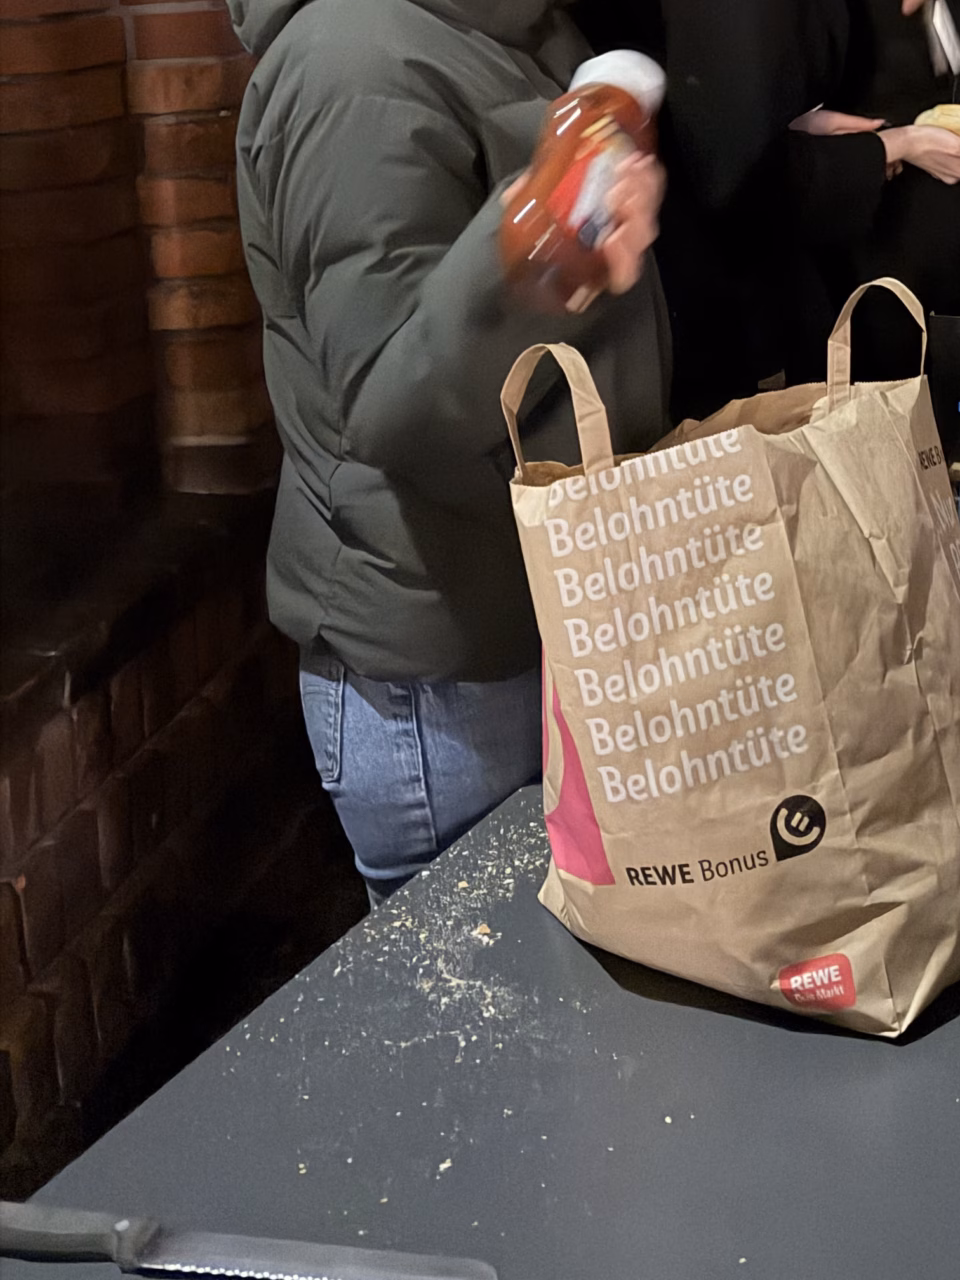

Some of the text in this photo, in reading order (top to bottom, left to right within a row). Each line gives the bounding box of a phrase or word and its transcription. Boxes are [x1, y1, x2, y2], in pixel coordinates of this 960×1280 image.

[544, 474, 754, 558] Belohntüte
[554, 523, 765, 608] Belohntüte
[564, 571, 776, 658] Belohntüte
[574, 621, 786, 708] Belohntüte
[585, 671, 798, 757] Belohntüte
[597, 724, 809, 804] Belohntüte
[626, 849, 769, 886] REWE Bonus
[790, 965, 842, 991] REWE
[815, 985, 844, 1001] Markt
